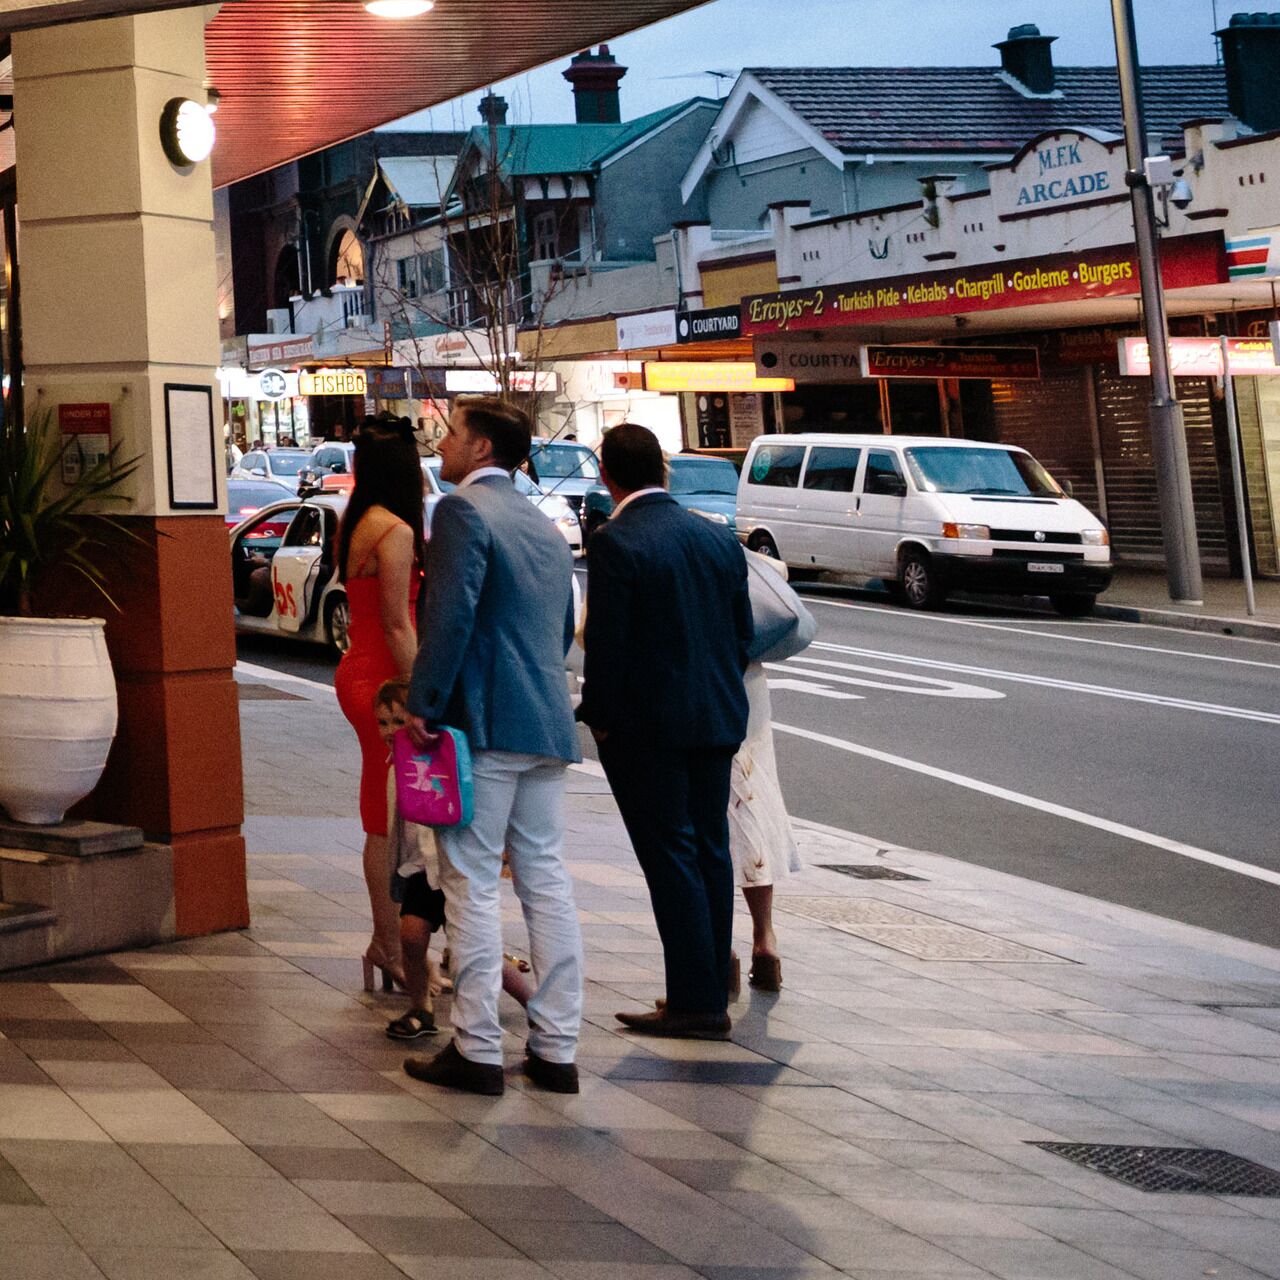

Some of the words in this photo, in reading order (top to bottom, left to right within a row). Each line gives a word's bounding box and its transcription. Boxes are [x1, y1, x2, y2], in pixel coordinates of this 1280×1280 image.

[1017, 171, 1110, 206] ARCADE
[838, 290, 875, 312] Turkish
[876, 287, 900, 308] Pide
[907, 281, 948, 304] Kebabs
[955, 273, 1005, 300] Chargrill
[1013, 268, 1069, 291] Gozleme
[1078, 261, 1133, 286] Burgers
[692, 315, 739, 334] COURTYARD
[789, 352, 859, 368] COURTYA
[313, 375, 366, 393] FISHBO
